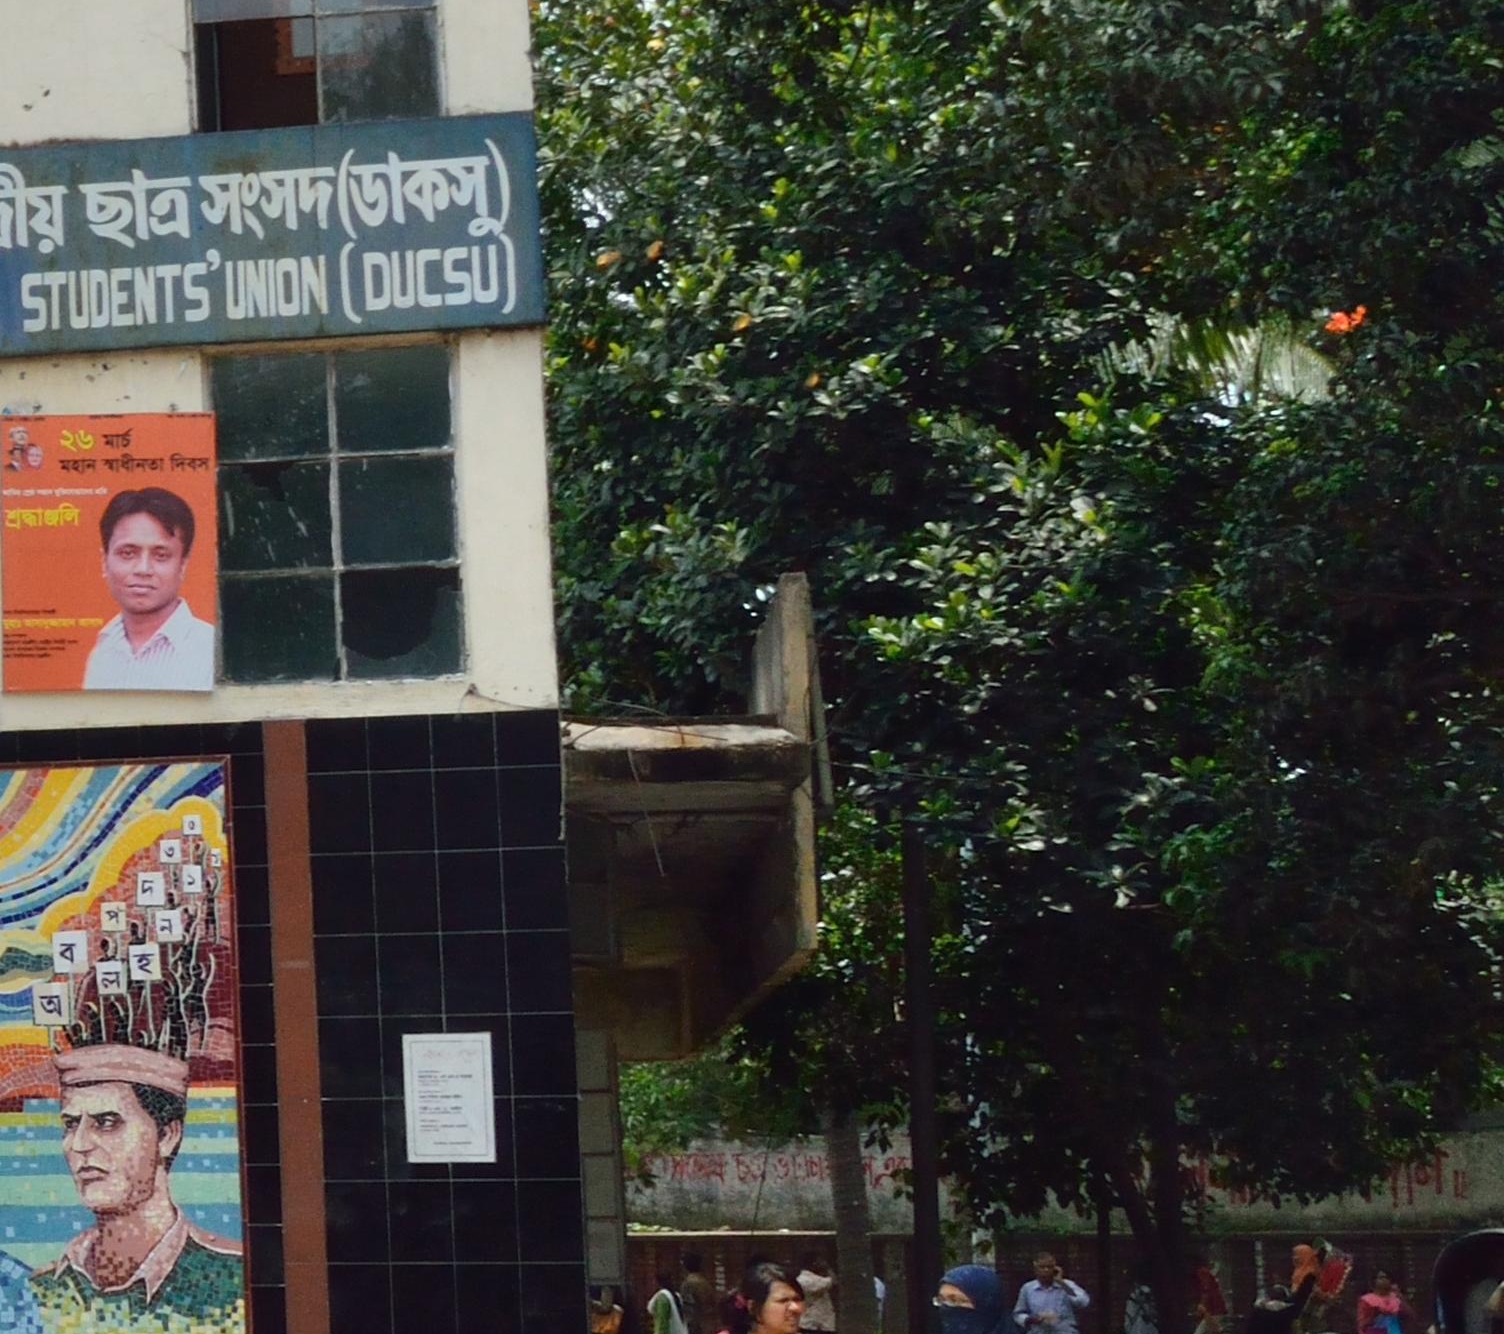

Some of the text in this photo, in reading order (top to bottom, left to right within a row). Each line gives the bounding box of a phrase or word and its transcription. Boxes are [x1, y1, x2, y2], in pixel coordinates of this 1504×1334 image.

[79, 168, 192, 248] ছাত্র
[59, 428, 133, 452] ২৬ মার্চ
[59, 452, 210, 474] মহান স্বাধীনতা দিবস
